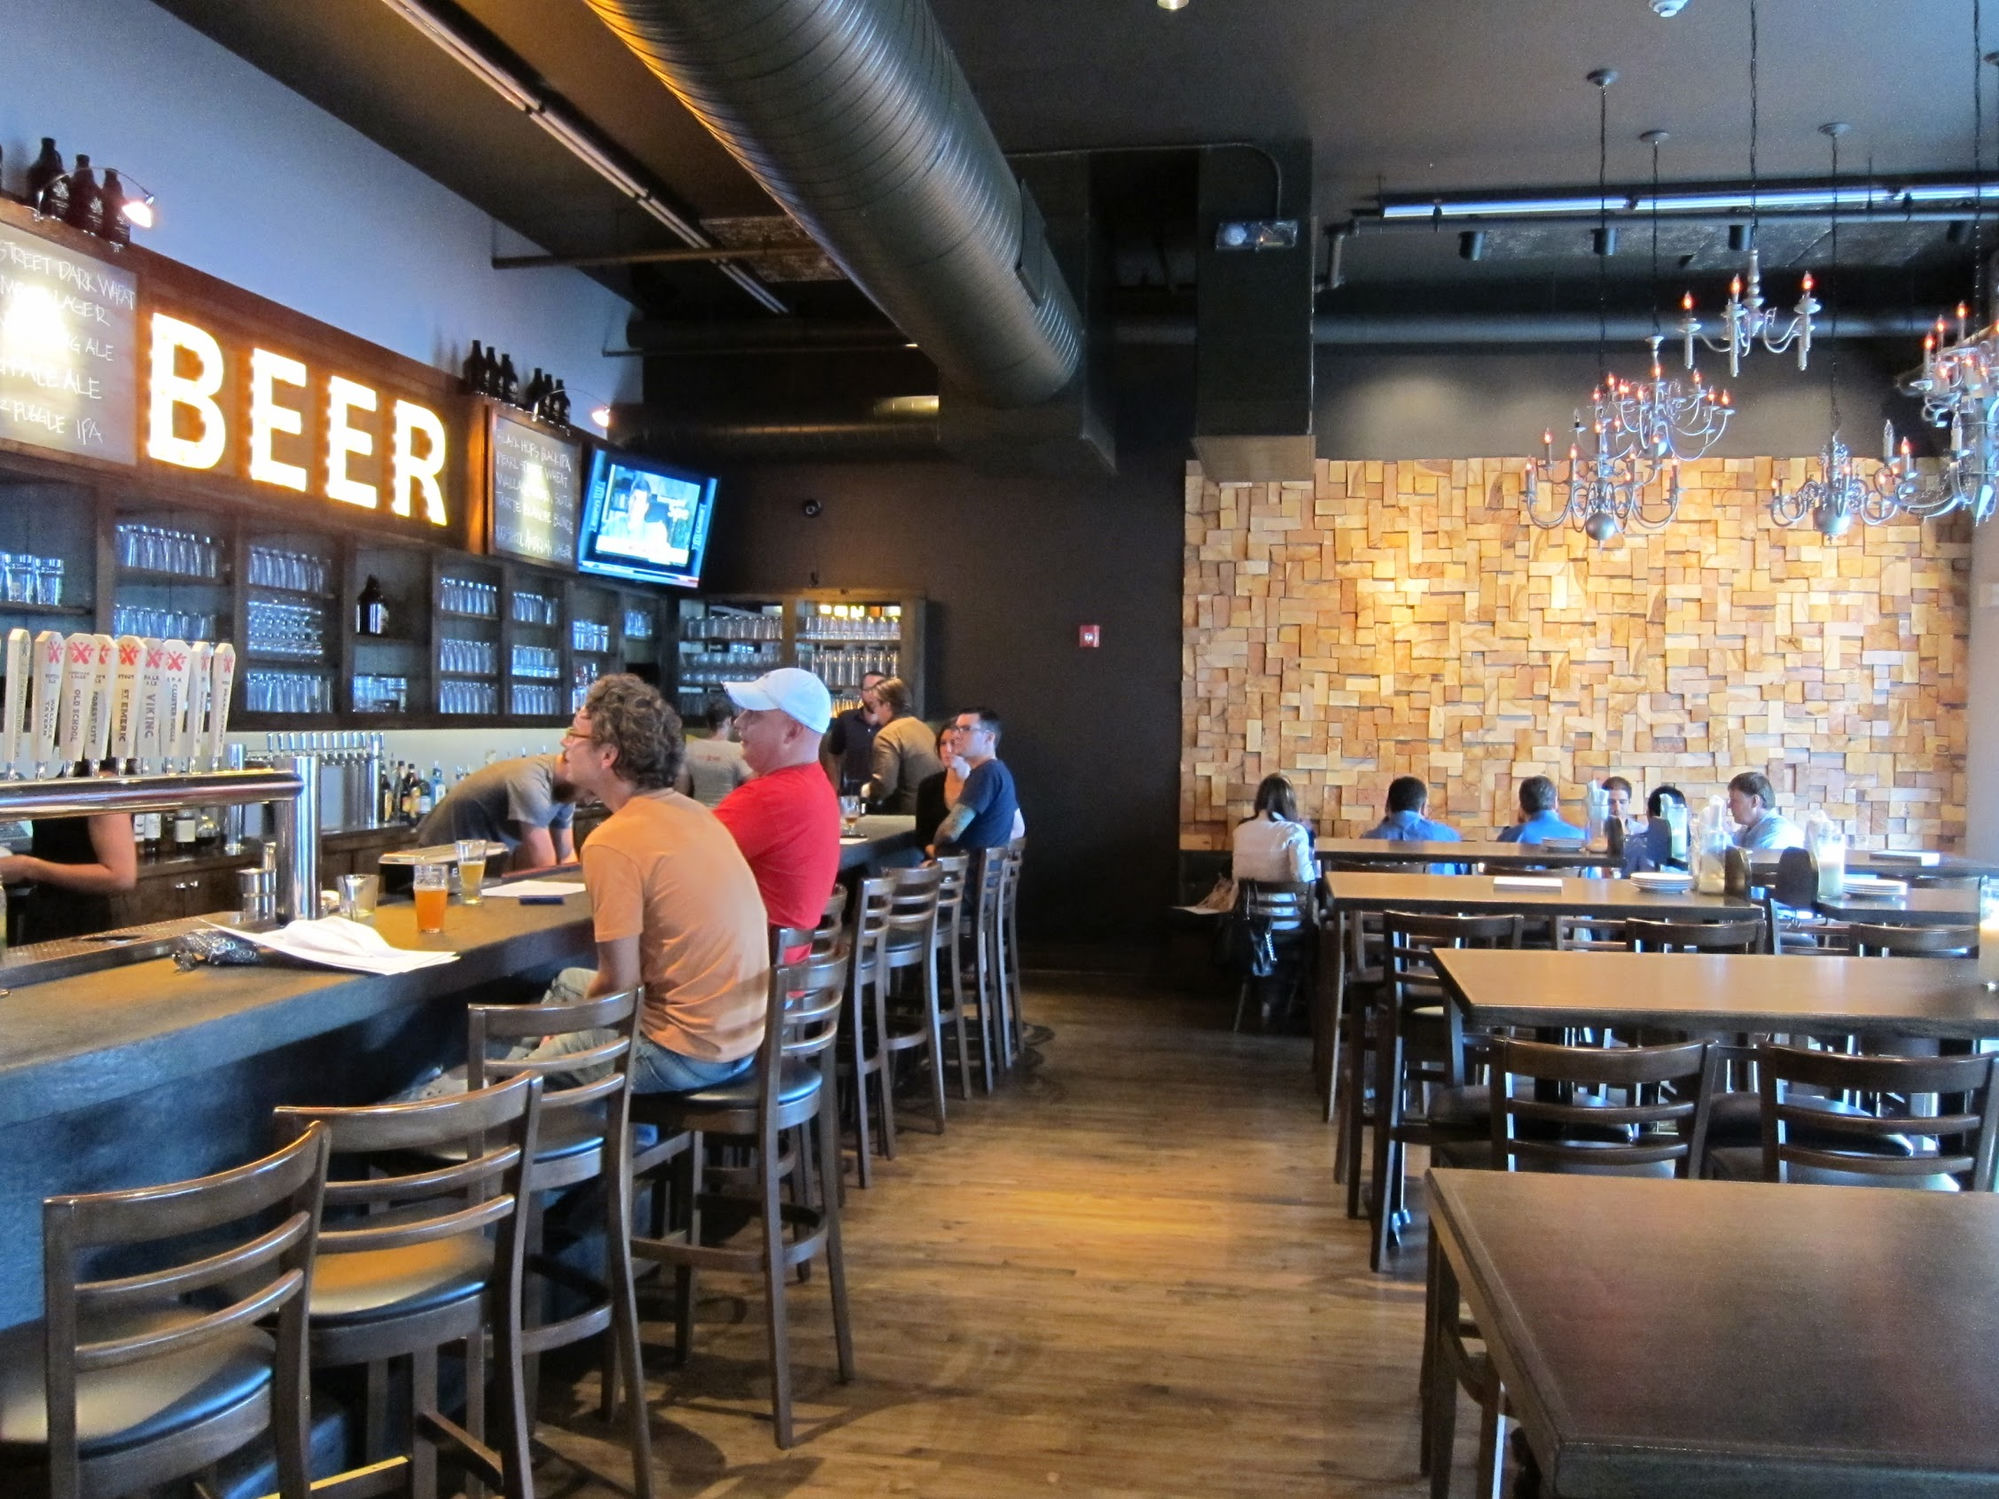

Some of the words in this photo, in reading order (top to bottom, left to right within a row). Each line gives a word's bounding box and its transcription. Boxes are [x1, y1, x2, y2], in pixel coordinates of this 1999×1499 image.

[58, 261, 97, 292] DARK
[85, 337, 114, 361] ALE
[63, 367, 102, 399] ALE
[76, 417, 104, 445] IPA
[148, 311, 448, 526] BEER
[73, 689, 81, 706] OLD
[70, 708, 80, 742] SCHOOL
